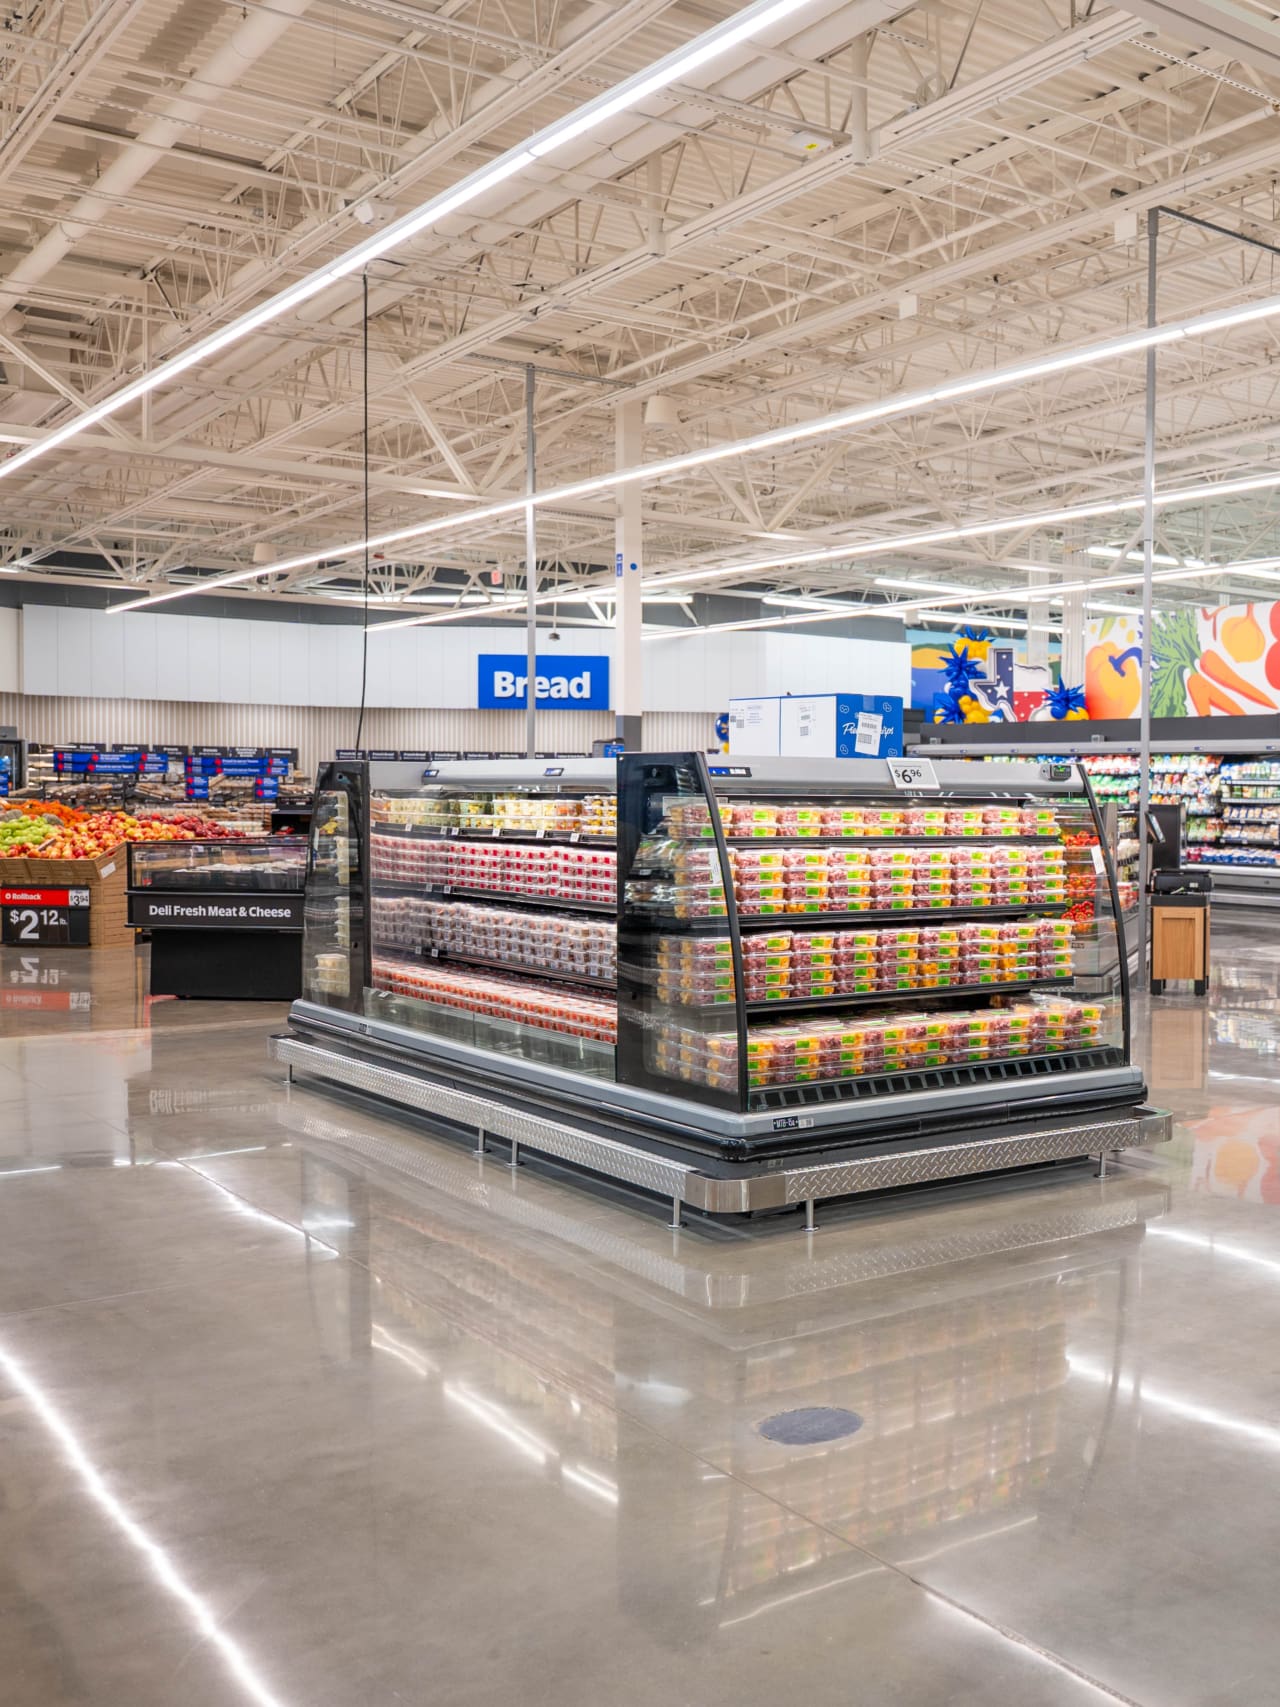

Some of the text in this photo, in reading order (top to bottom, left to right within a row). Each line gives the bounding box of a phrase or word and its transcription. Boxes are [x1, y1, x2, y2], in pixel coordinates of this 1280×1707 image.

[493, 670, 592, 700] Bread
[11, 892, 42, 901] Rollback
[149, 905, 292, 918] Deli Fresh Meat & Cheese
